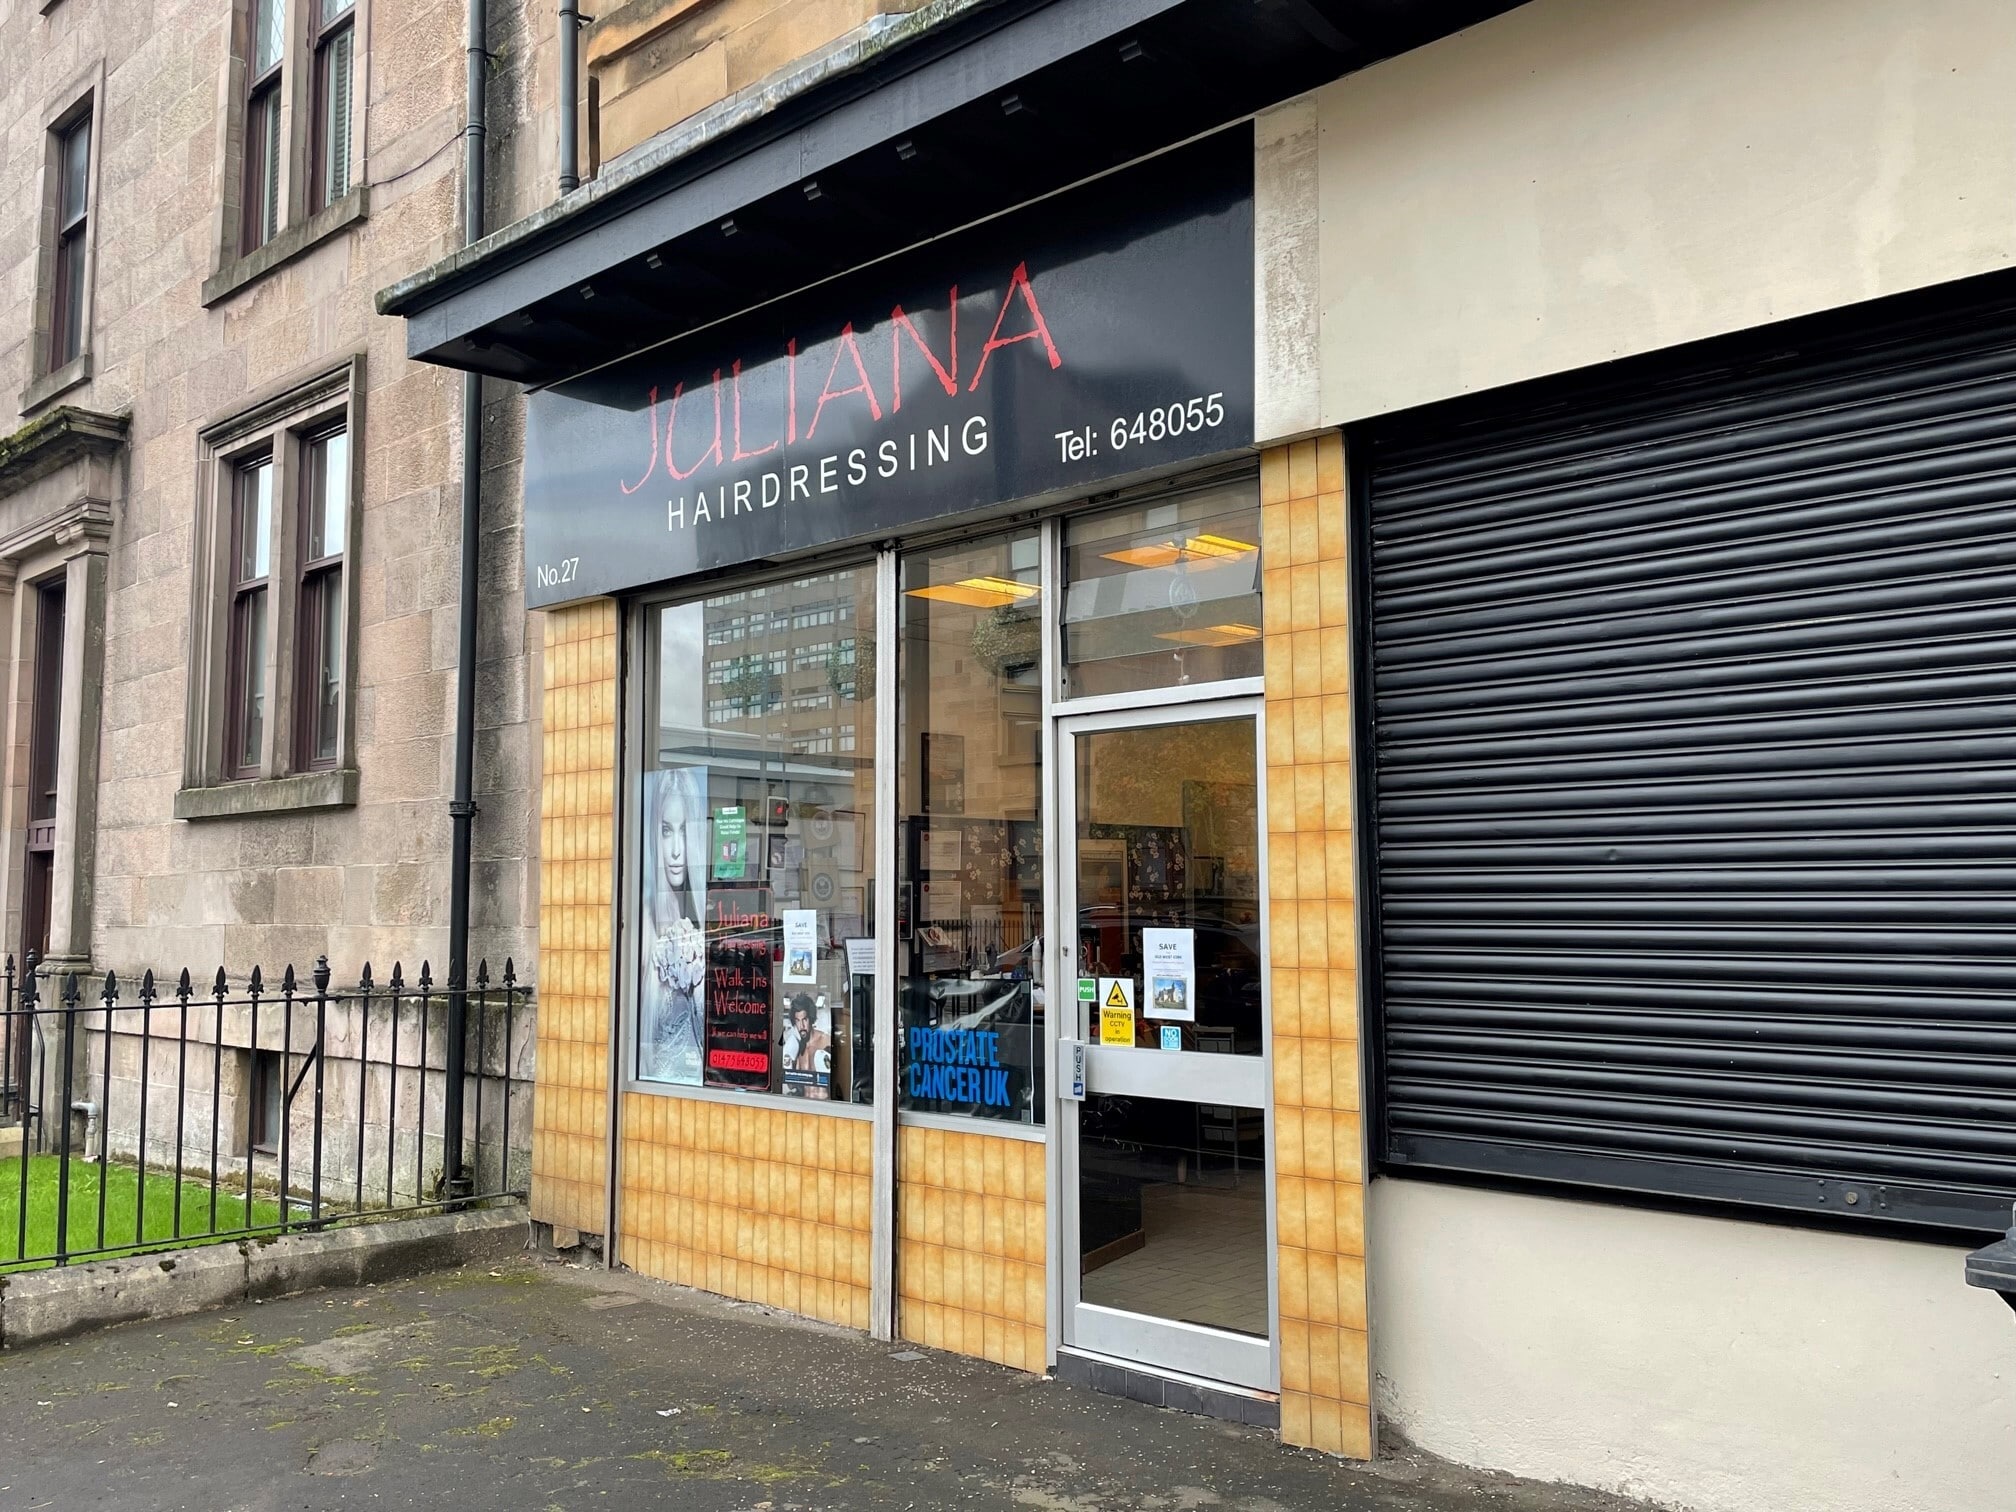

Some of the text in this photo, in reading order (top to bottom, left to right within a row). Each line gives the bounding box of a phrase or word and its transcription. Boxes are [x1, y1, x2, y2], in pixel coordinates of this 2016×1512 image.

[620, 260, 1062, 495] JULIANA
[1054, 391, 1225, 463] Tel: 648055
[666, 415, 988, 532] HAIRDRESSING
[537, 557, 580, 589] No.27
[709, 900, 769, 933] Juliana
[1158, 943, 1177, 951] SAVE
[713, 990, 767, 1016] Welcome
[1079, 986, 1094, 994] PUSH
[1103, 1010, 1132, 1021] Warning
[910, 1026, 1000, 1068] PROSTATE
[1164, 1029, 1177, 1037] NO
[910, 1062, 1011, 1107] CANCER UK
